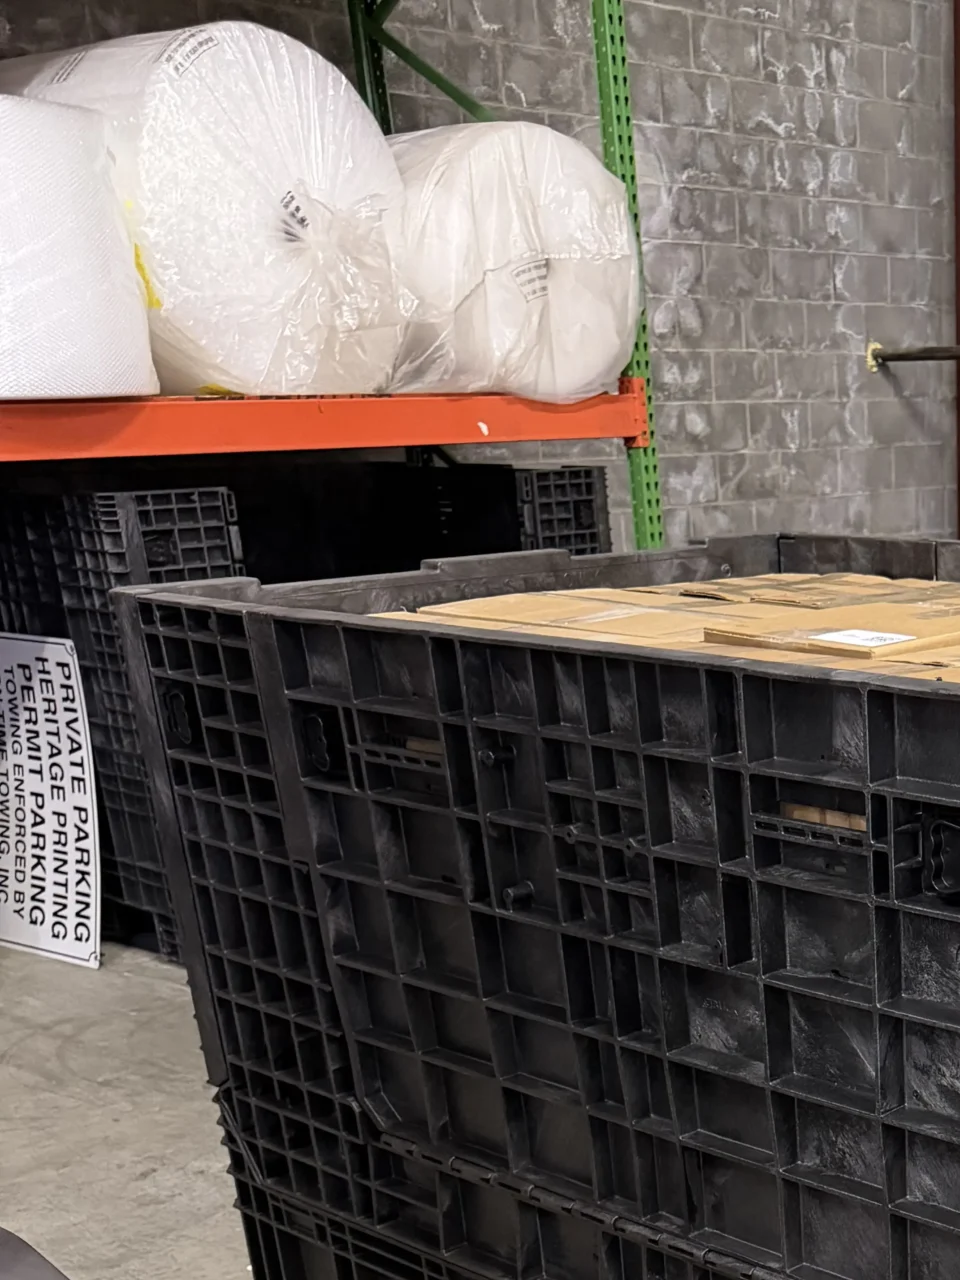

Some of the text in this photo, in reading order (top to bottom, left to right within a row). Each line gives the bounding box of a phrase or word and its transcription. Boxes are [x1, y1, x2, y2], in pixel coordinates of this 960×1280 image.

[4, 666, 27, 919] TOWING ENFORCED BY
[17, 663, 47, 926] PERMIT PARKING
[35, 656, 68, 940] HERITAGE PRINTING
[56, 661, 91, 944] PRIVATE PARKING
